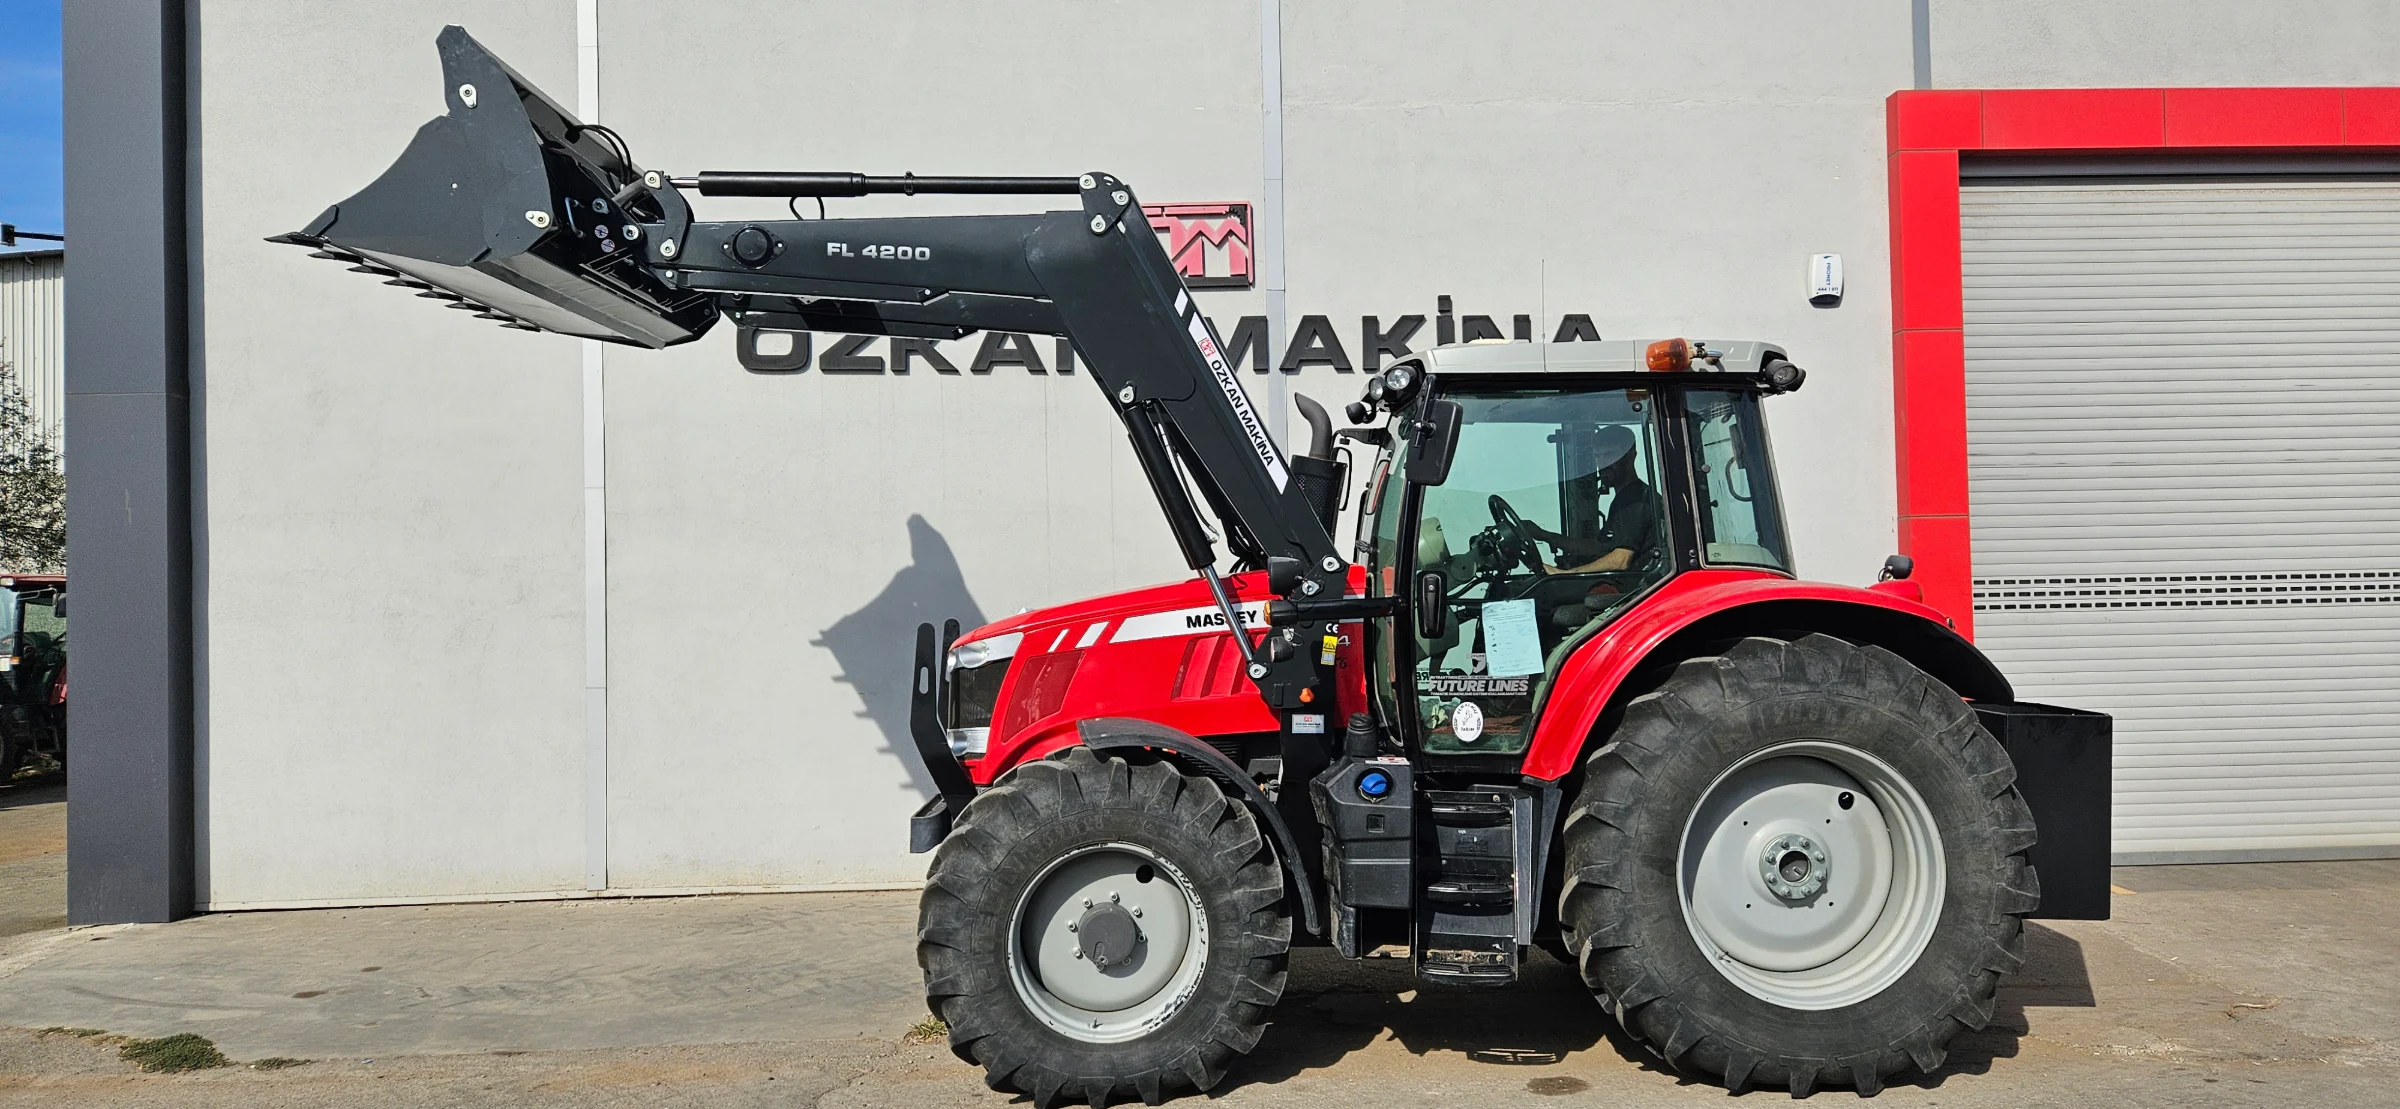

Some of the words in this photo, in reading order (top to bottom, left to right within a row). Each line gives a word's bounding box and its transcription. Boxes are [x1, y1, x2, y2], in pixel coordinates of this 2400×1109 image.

[827, 242, 854, 258] FL
[862, 244, 931, 261] 4200
[1211, 359, 1244, 409] ÖZKAN
[1239, 410, 1275, 467] MAKİNA
[1186, 610, 1258, 628] MASEY
[1325, 623, 1339, 634] CE
[1428, 680, 1486, 691] FUTURE
[1487, 680, 1529, 692] LINES
